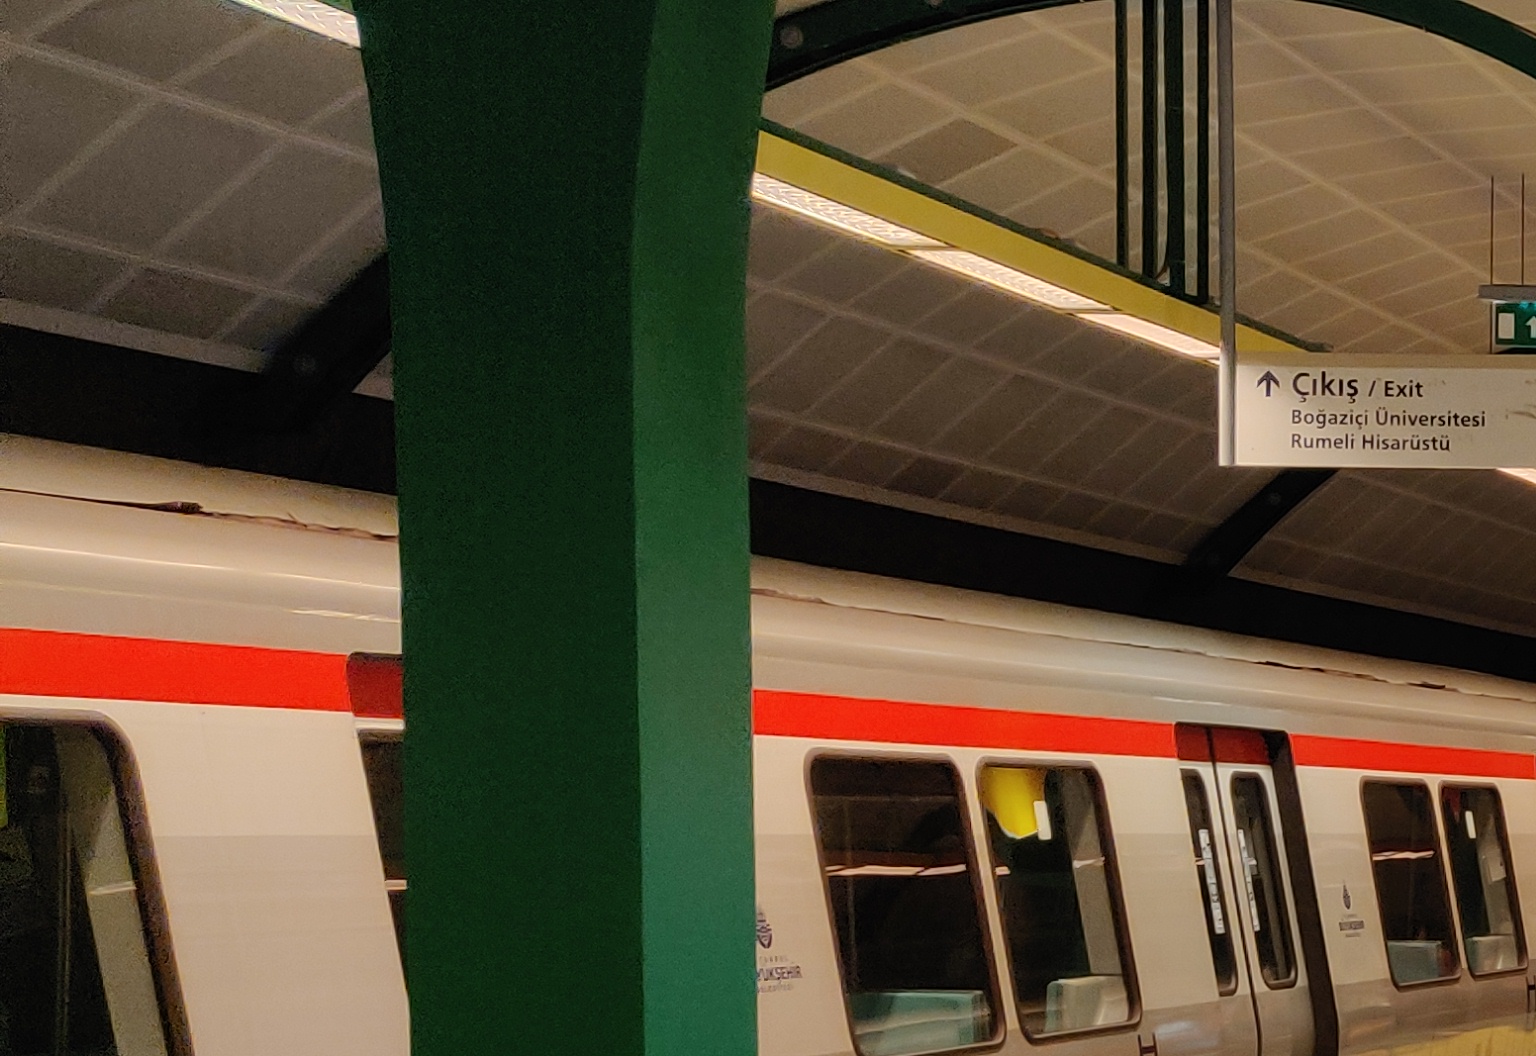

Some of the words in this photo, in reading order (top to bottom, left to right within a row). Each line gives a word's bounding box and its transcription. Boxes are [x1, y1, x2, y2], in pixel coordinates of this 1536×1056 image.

[1292, 370, 1359, 404] Çıkış
[1383, 380, 1424, 398] Exit
[1291, 408, 1369, 431] Boğaziçi
[1375, 406, 1486, 428] Üniversitesi
[1291, 433, 1355, 450] Rumeli
[1361, 433, 1451, 452] Hisarüstü
